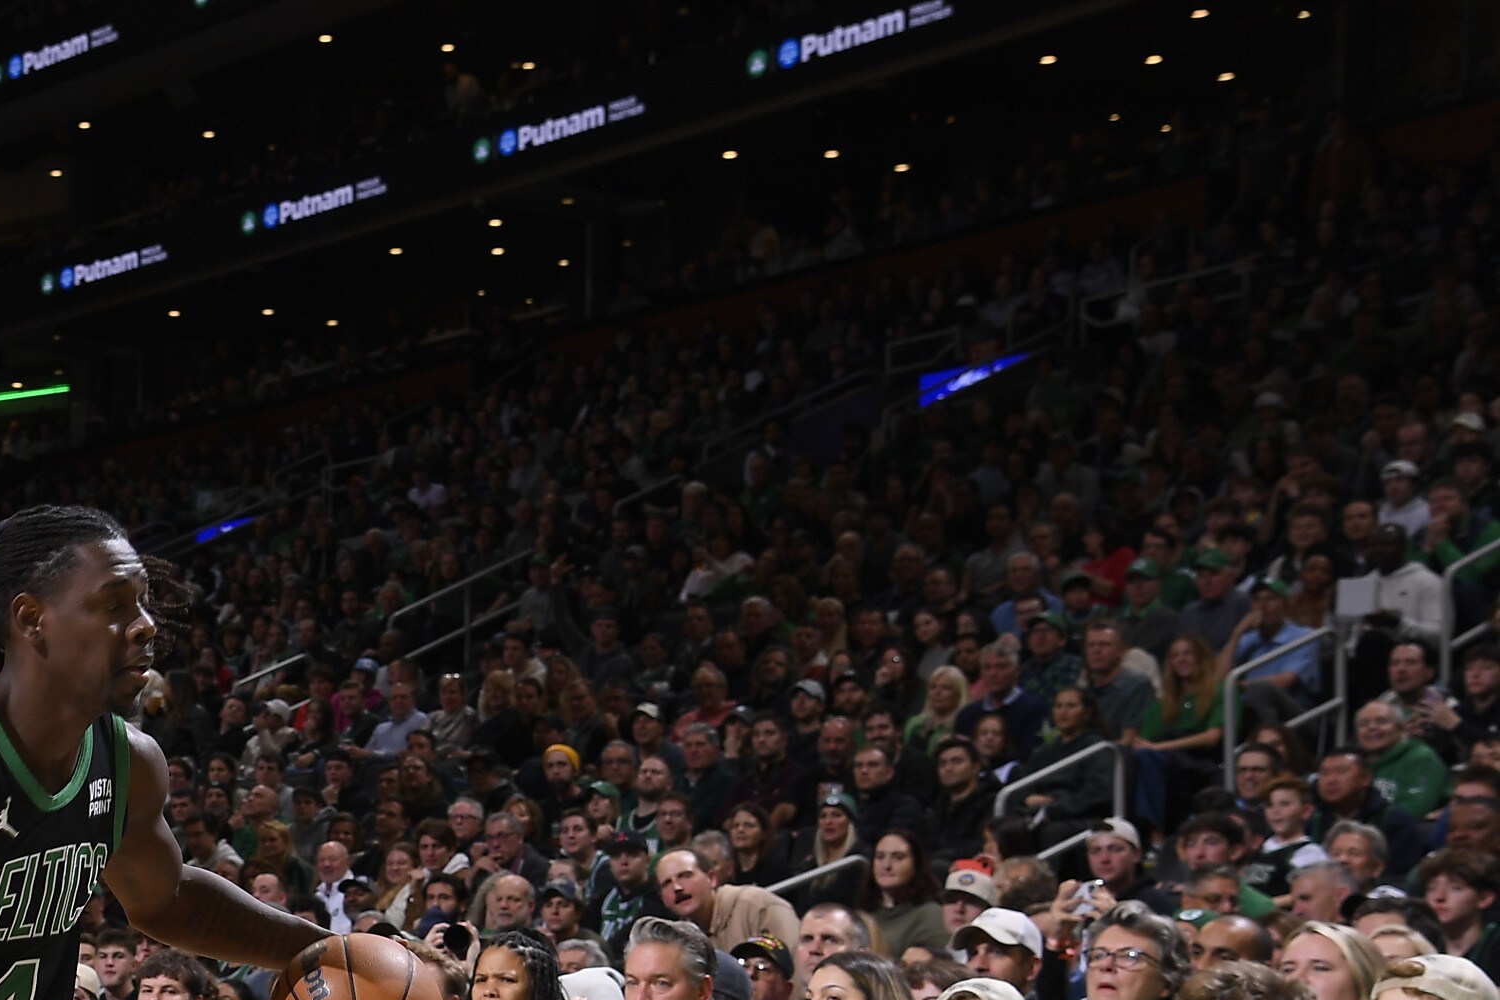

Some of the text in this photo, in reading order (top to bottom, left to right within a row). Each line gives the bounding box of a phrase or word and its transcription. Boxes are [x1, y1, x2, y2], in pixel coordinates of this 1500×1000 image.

[22, 34, 89, 75] Putnam
[800, 10, 905, 63] Putnam
[518, 105, 605, 151] Putnam
[279, 185, 354, 225] Putnam
[73, 251, 139, 286] Putnam
[88, 798, 112, 818] PRINT
[89, 778, 113, 801] VISTA
